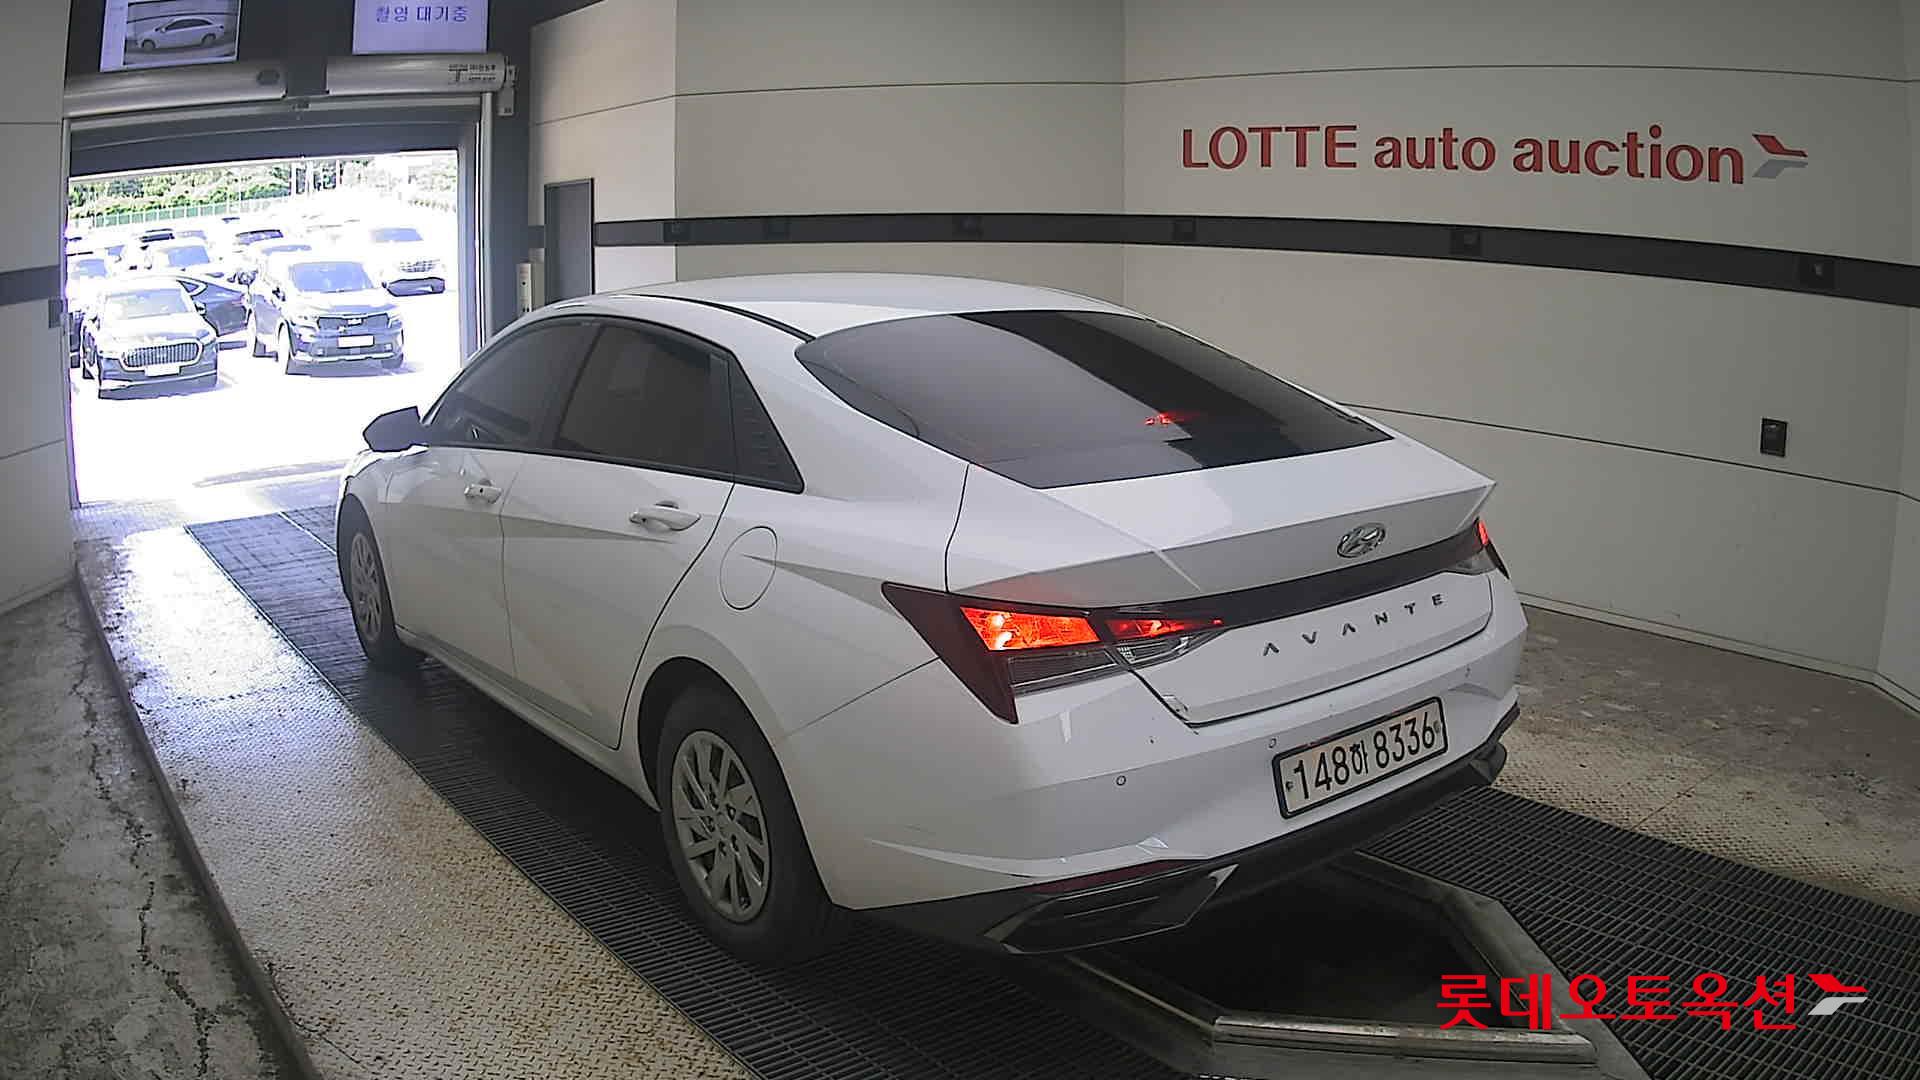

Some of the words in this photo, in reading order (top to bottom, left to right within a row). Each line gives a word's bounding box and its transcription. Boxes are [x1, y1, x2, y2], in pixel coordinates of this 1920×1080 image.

[416, 6, 467, 22] 대기중
[1182, 125, 1357, 169] LOTTE
[1374, 127, 1496, 171] auto
[1513, 124, 1744, 184] auction
[1263, 594, 1443, 656] AVANTE
[1373, 711, 1435, 768] 8336
